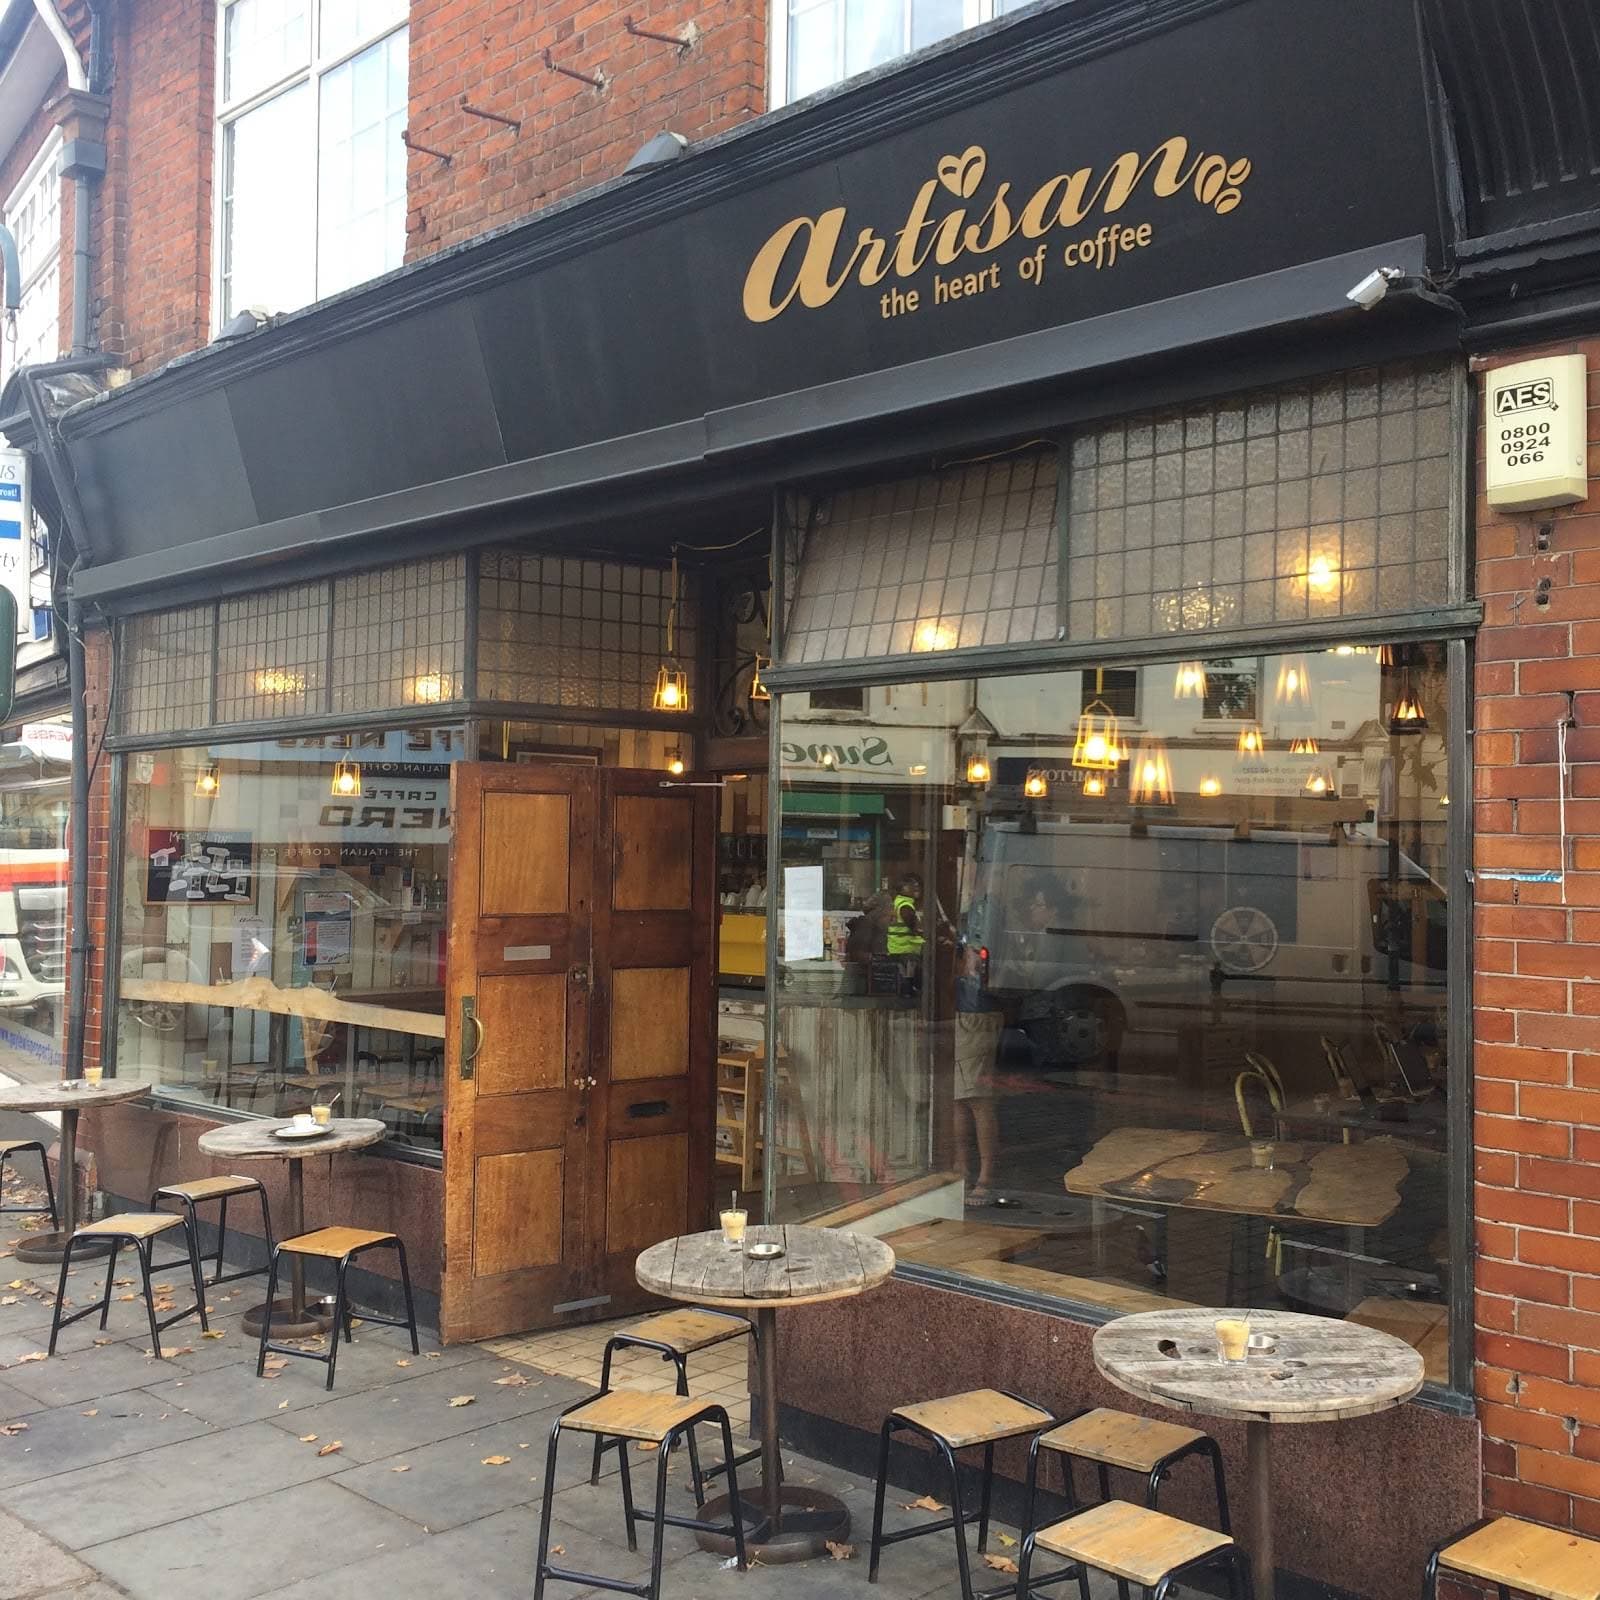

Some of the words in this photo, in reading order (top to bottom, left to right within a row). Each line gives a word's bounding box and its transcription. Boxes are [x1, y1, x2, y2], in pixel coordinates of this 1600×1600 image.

[881, 289, 920, 319] the
[934, 264, 1001, 305] heart
[1019, 244, 1047, 285] of
[1064, 222, 1153, 271] coffee
[1498, 382, 1551, 413] AES
[1501, 422, 1551, 441] 0800
[1501, 435, 1552, 455] 0924
[1507, 450, 1545, 467] 066
